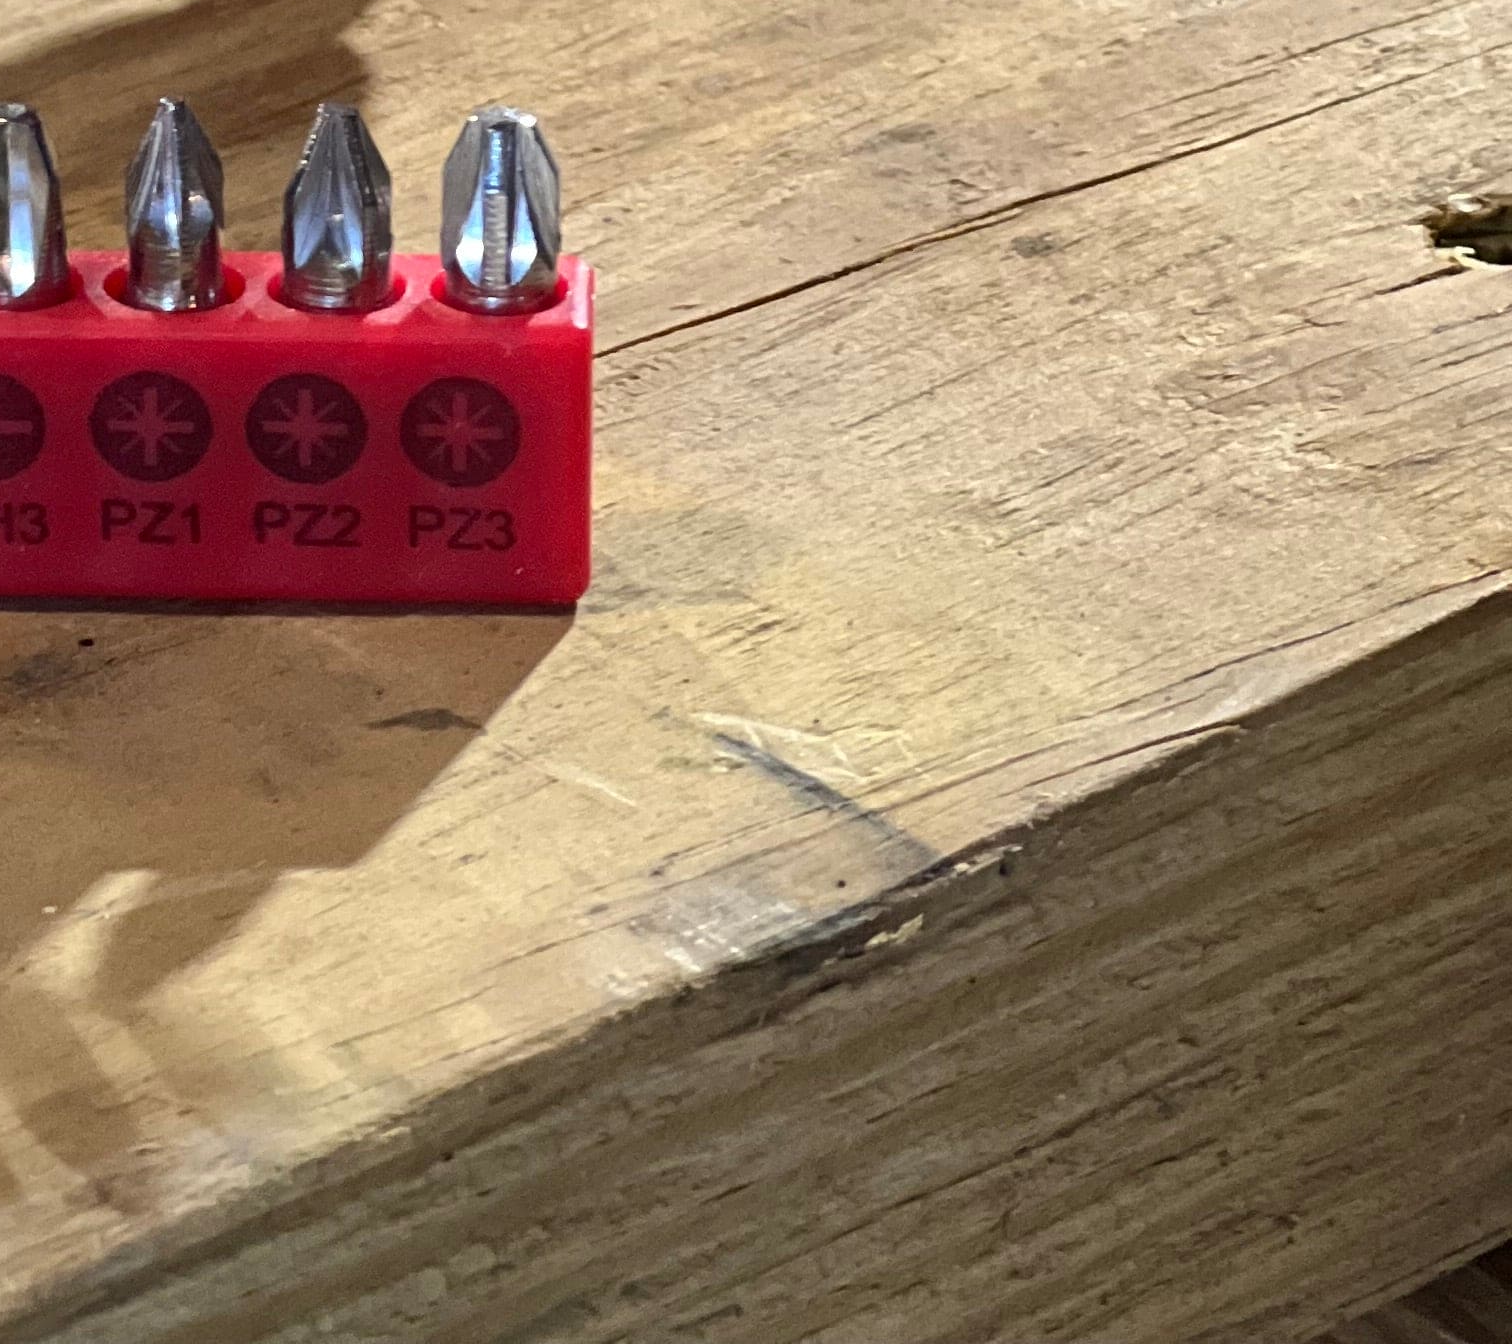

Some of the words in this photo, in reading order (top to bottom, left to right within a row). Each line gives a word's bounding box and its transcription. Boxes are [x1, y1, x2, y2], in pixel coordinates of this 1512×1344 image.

[101, 499, 203, 544] PZ1
[254, 502, 364, 547] PZ2
[409, 506, 519, 551] PZ3
